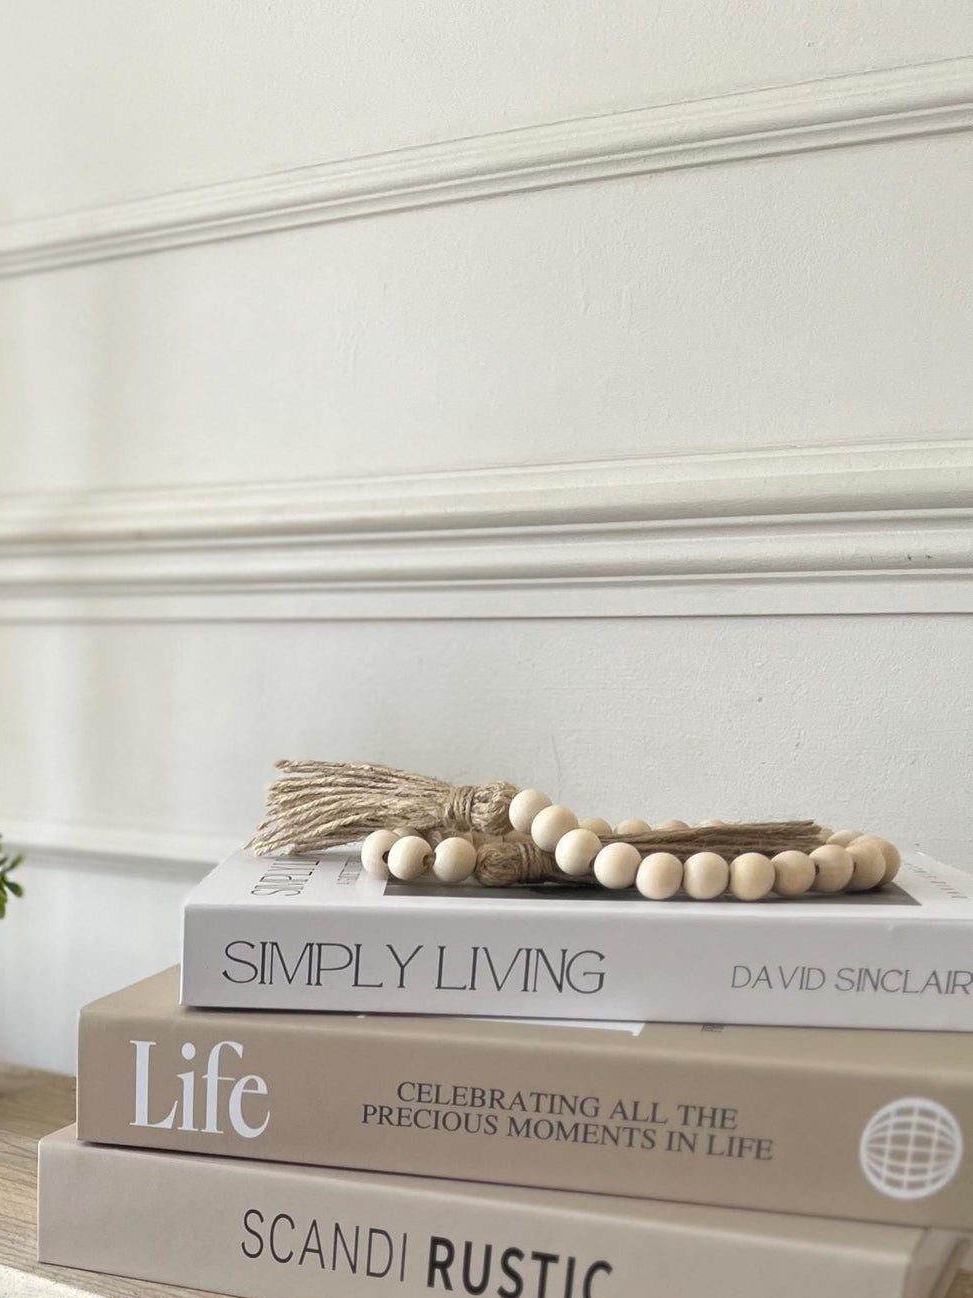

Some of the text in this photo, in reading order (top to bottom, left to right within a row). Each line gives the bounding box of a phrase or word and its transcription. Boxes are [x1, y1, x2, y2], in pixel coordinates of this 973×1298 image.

[222, 940, 606, 994] SIMPLY LIVING
[730, 965, 973, 995] DAVID SINCLAIR
[129, 1040, 271, 1138] Life
[396, 1081, 739, 1131] CELEBRATING ALL THE
[361, 1103, 775, 1161] PRECIOUS MOMENTS IN LIFE
[241, 1208, 408, 1282] SCANDI
